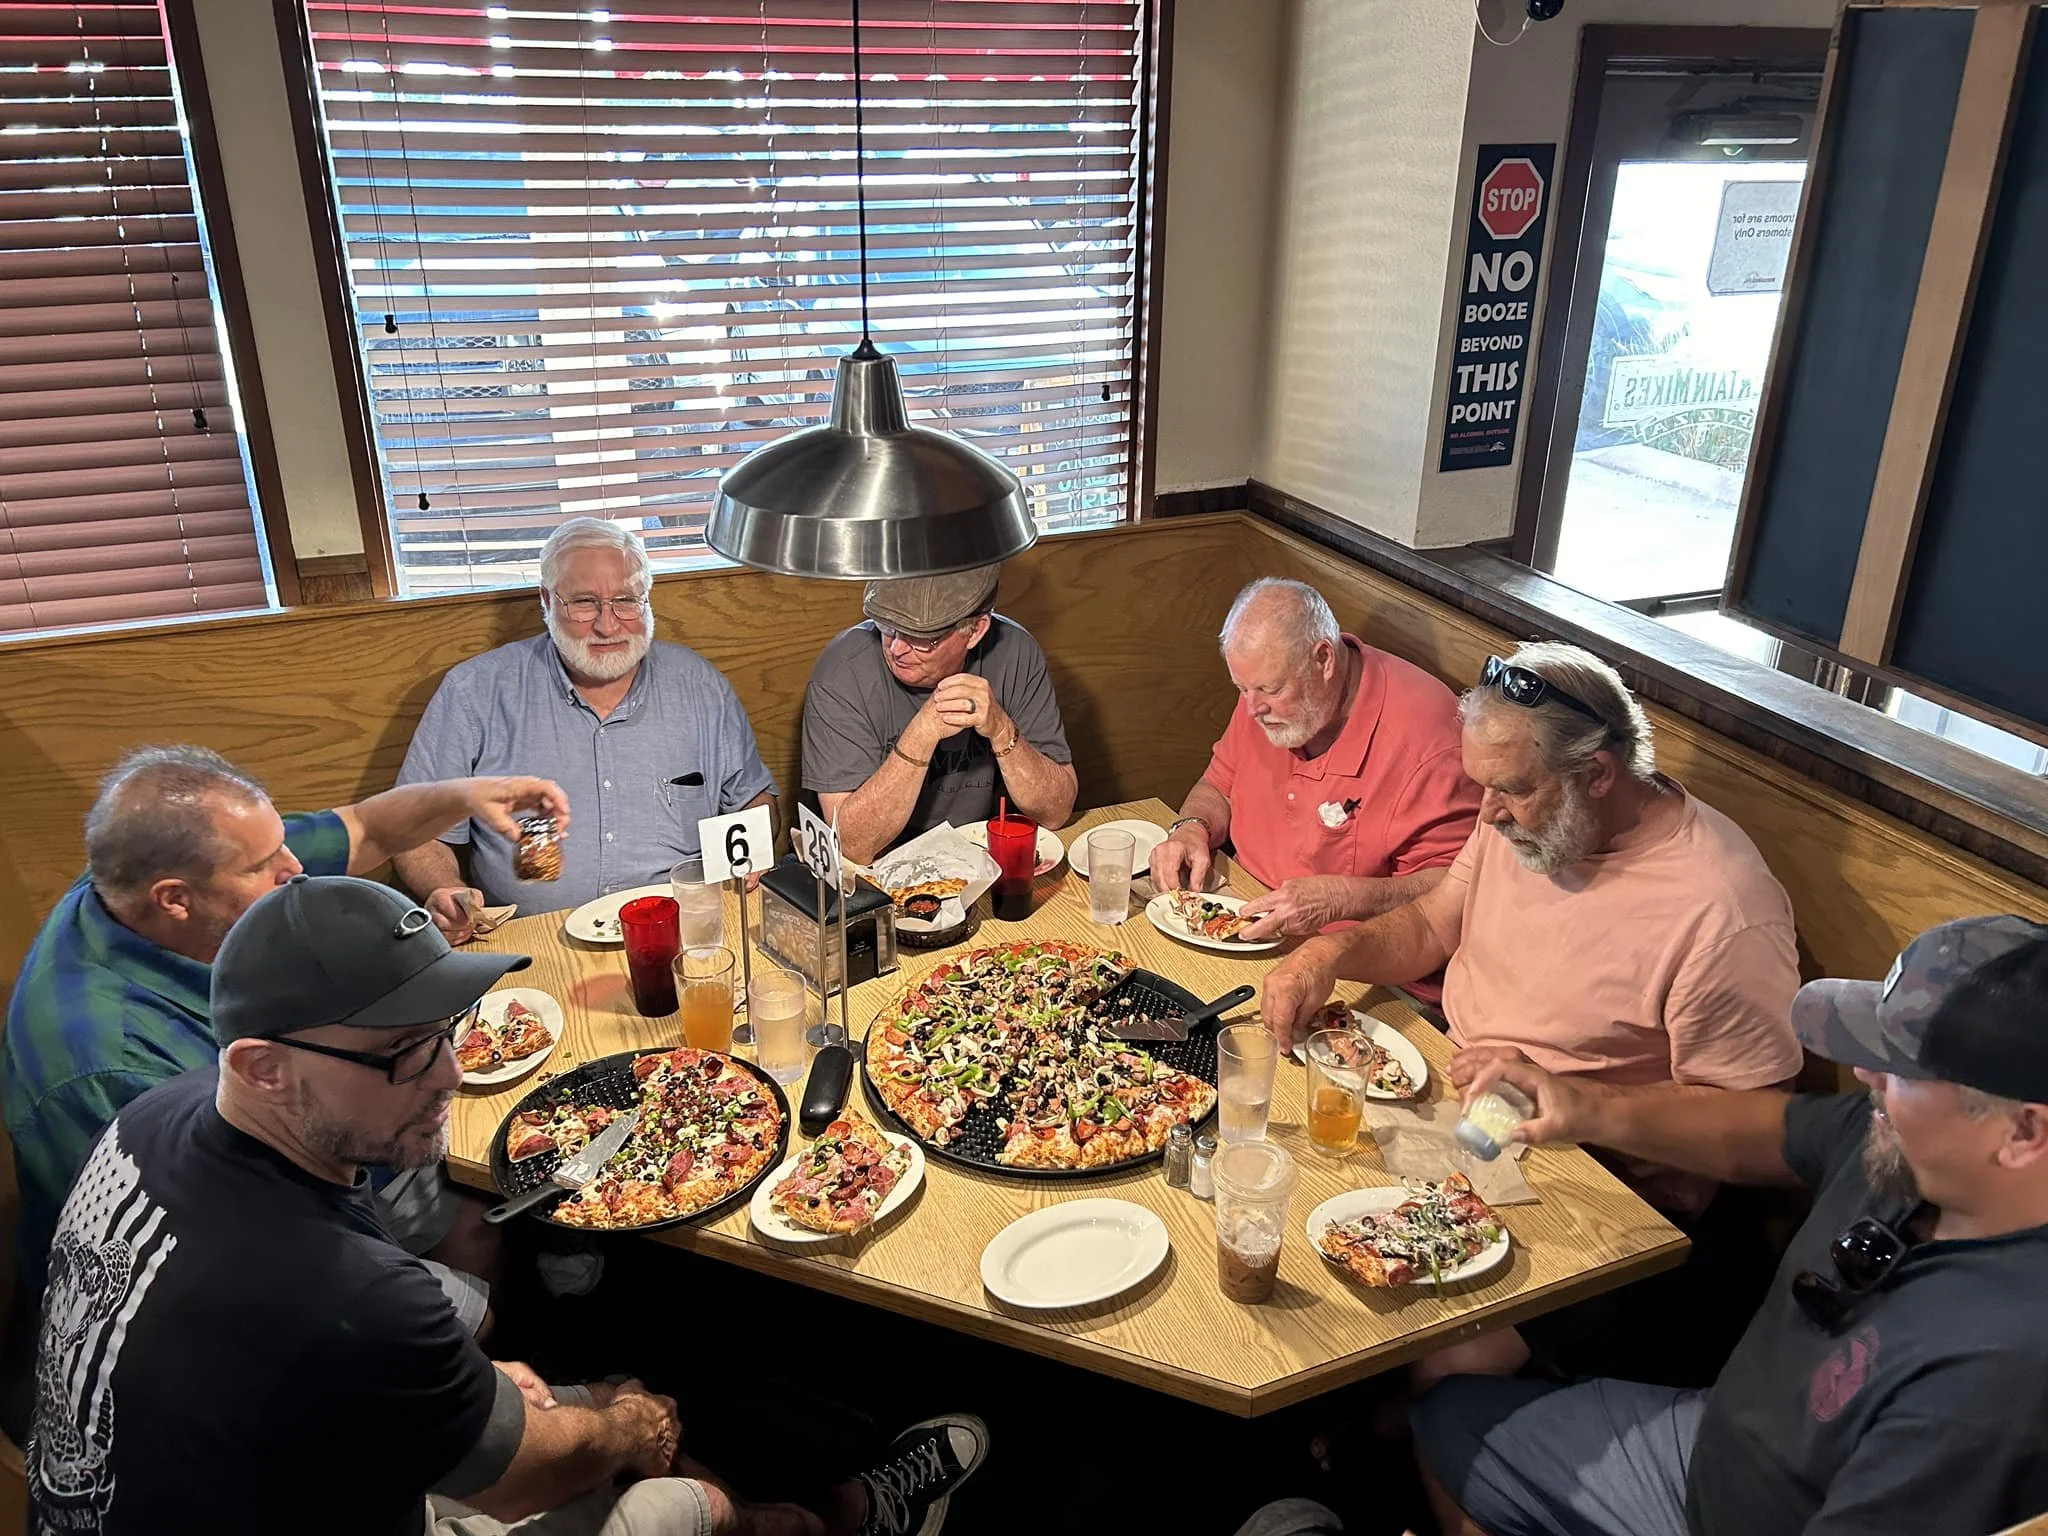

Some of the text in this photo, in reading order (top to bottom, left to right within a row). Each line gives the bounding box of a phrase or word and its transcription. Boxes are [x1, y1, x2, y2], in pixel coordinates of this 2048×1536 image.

[1486, 187, 1536, 212] STOP
[1468, 250, 1534, 293] NO
[1464, 302, 1528, 323] BOOZE
[1460, 334, 1523, 353] BEYOND
[1457, 361, 1519, 394] THIS
[1451, 400, 1516, 424] POINT
[725, 823, 750, 866] 6
[805, 819, 831, 874] 26
